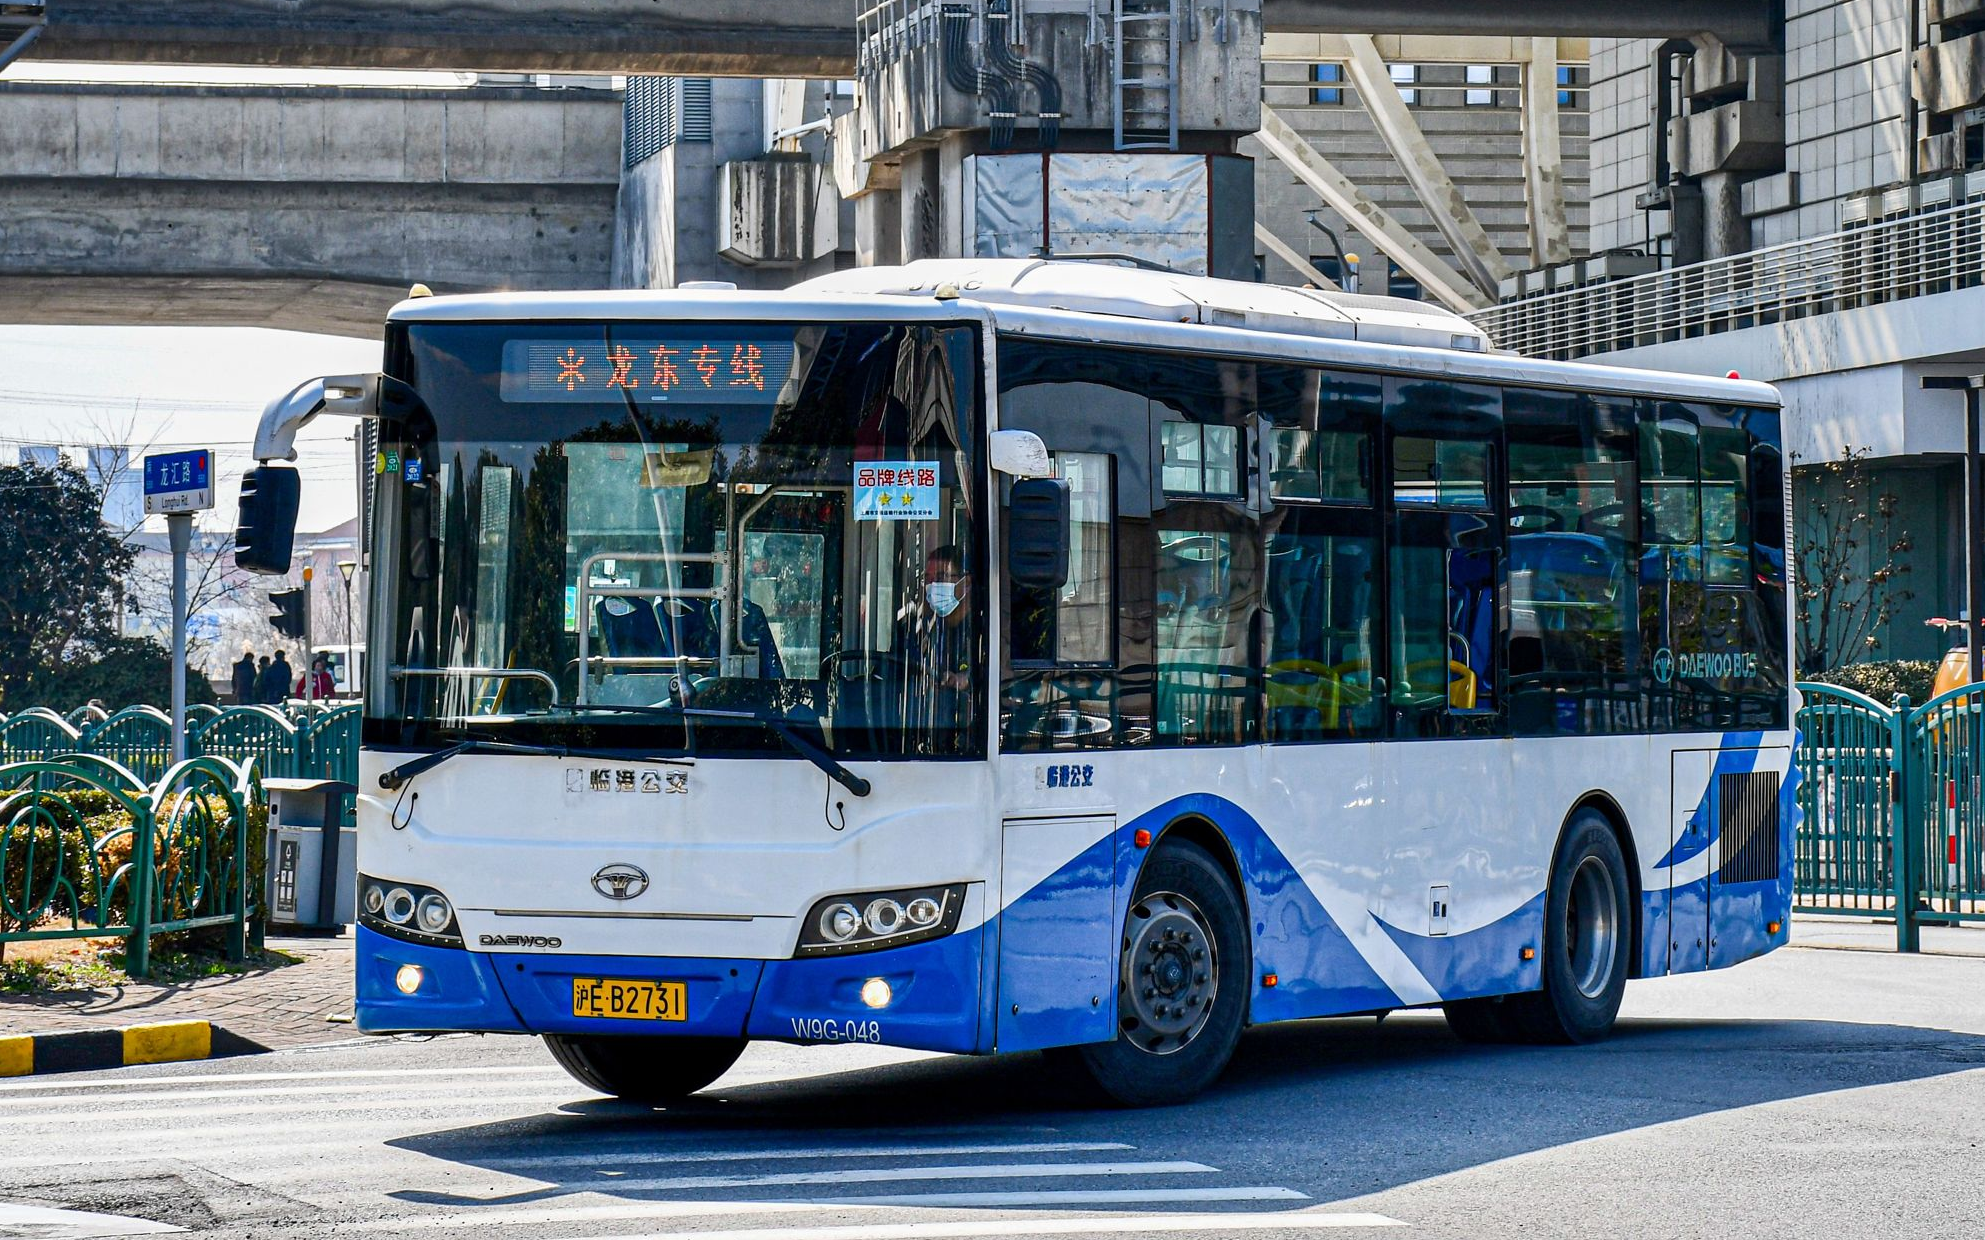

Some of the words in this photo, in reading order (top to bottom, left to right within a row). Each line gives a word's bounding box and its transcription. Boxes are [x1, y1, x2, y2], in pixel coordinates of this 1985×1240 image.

[606, 344, 764, 391] 龙东专线
[160, 460, 191, 486] 龙汇路
[858, 468, 935, 488] 品牌线路
[147, 495, 152, 510] S
[161, 495, 180, 511] Longhui
[198, 490, 204, 506] N
[1679, 653, 1732, 678] DAEWOO
[1733, 652, 1758, 678] BUS
[590, 768, 688, 793] 临港公交
[1047, 764, 1093, 788] 临港公交
[479, 934, 562, 949] DAEWOO
[791, 1017, 880, 1043] W9G-048
